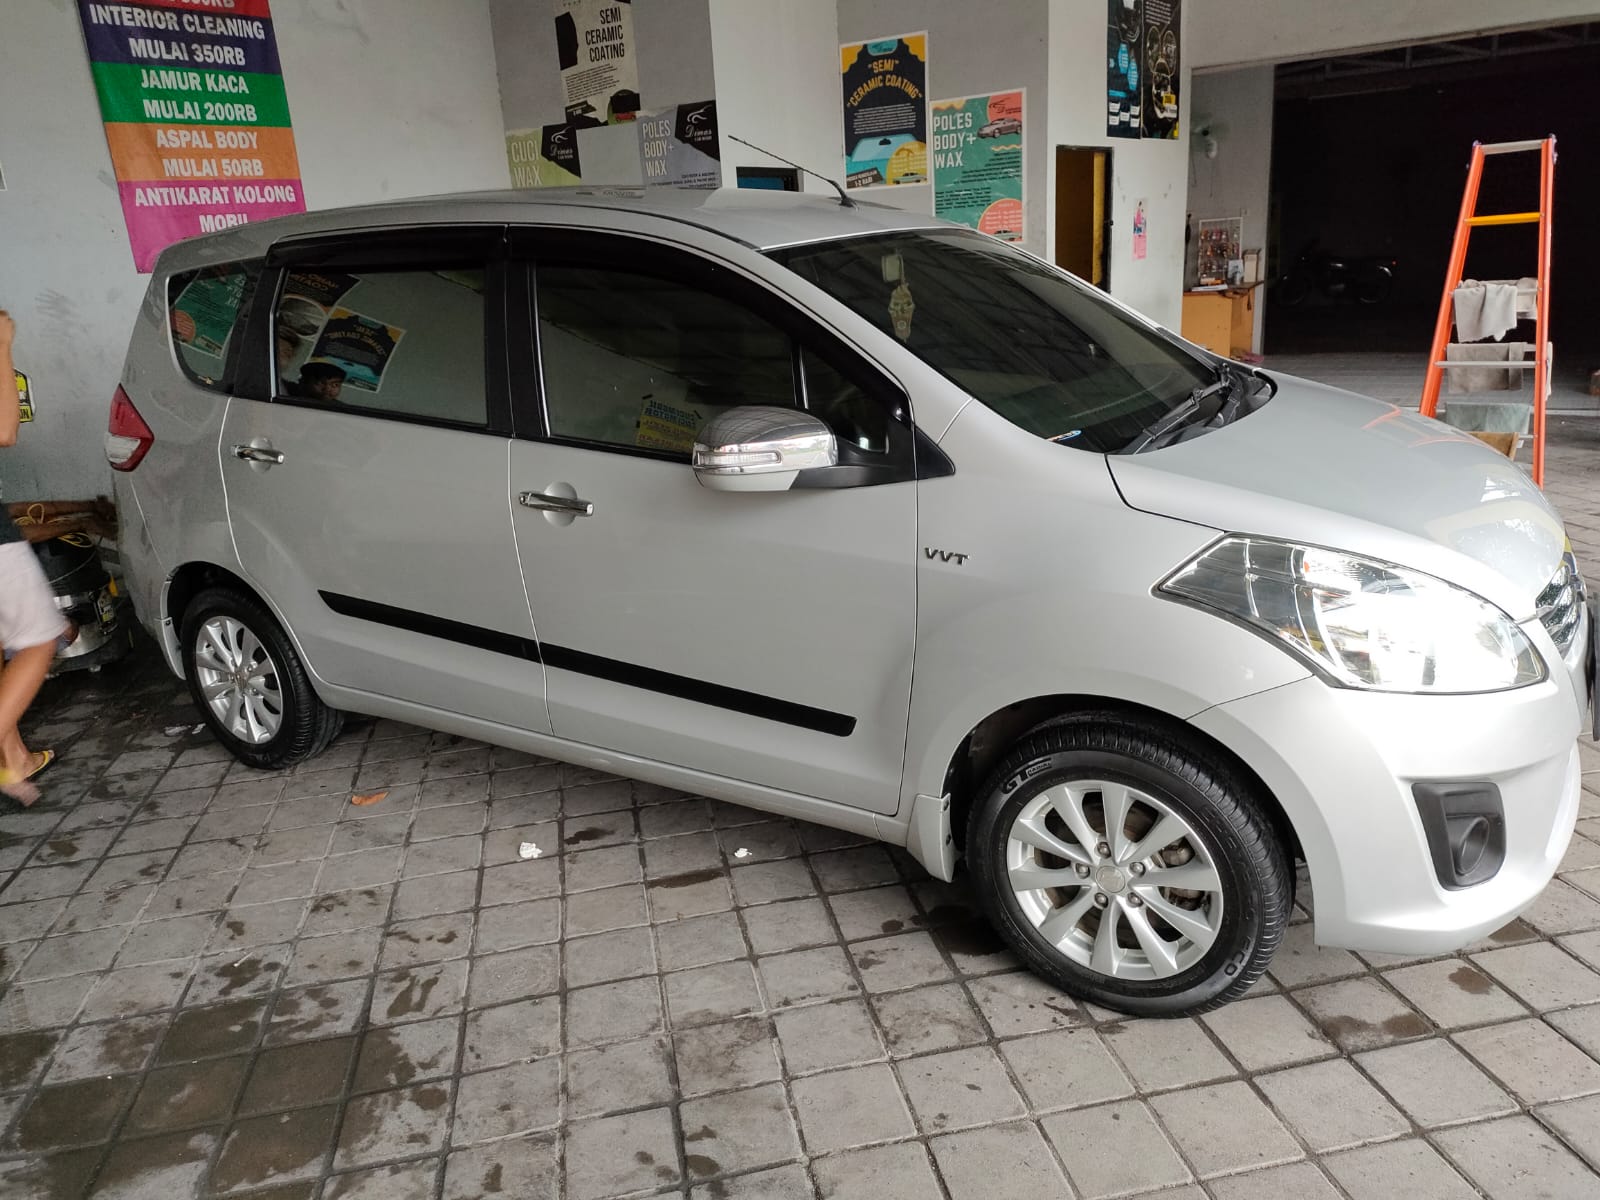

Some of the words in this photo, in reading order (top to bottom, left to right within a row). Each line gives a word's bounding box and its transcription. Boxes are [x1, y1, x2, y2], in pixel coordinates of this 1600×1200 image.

[90, 5, 180, 31] INTERIOR
[185, 15, 265, 40] CLEANING
[600, 6, 622, 25] SEMI
[585, 24, 624, 46] CERAMIC
[129, 37, 189, 62] MULAI
[191, 43, 246, 66] 350RB
[589, 42, 625, 62] COATING
[141, 69, 202, 92] JAMUR
[206, 74, 249, 94] KACA
[144, 99, 200, 121] MULAI
[204, 102, 257, 122] 200RB
[642, 119, 671, 140] POLES
[934, 112, 973, 132] POLES
[157, 129, 213, 149] ASPAL
[216, 131, 258, 149] BODY
[511, 140, 539, 163] CUCI
[935, 151, 964, 169] WAX
[163, 158, 217, 177] MULAI
[222, 159, 264, 177] 50RB
[513, 165, 544, 188] WAX
[646, 159, 668, 177] WAX
[135, 186, 230, 207] ANTIKARAT
[234, 185, 296, 205] KOLONG
[924, 547, 970, 566] VVT
